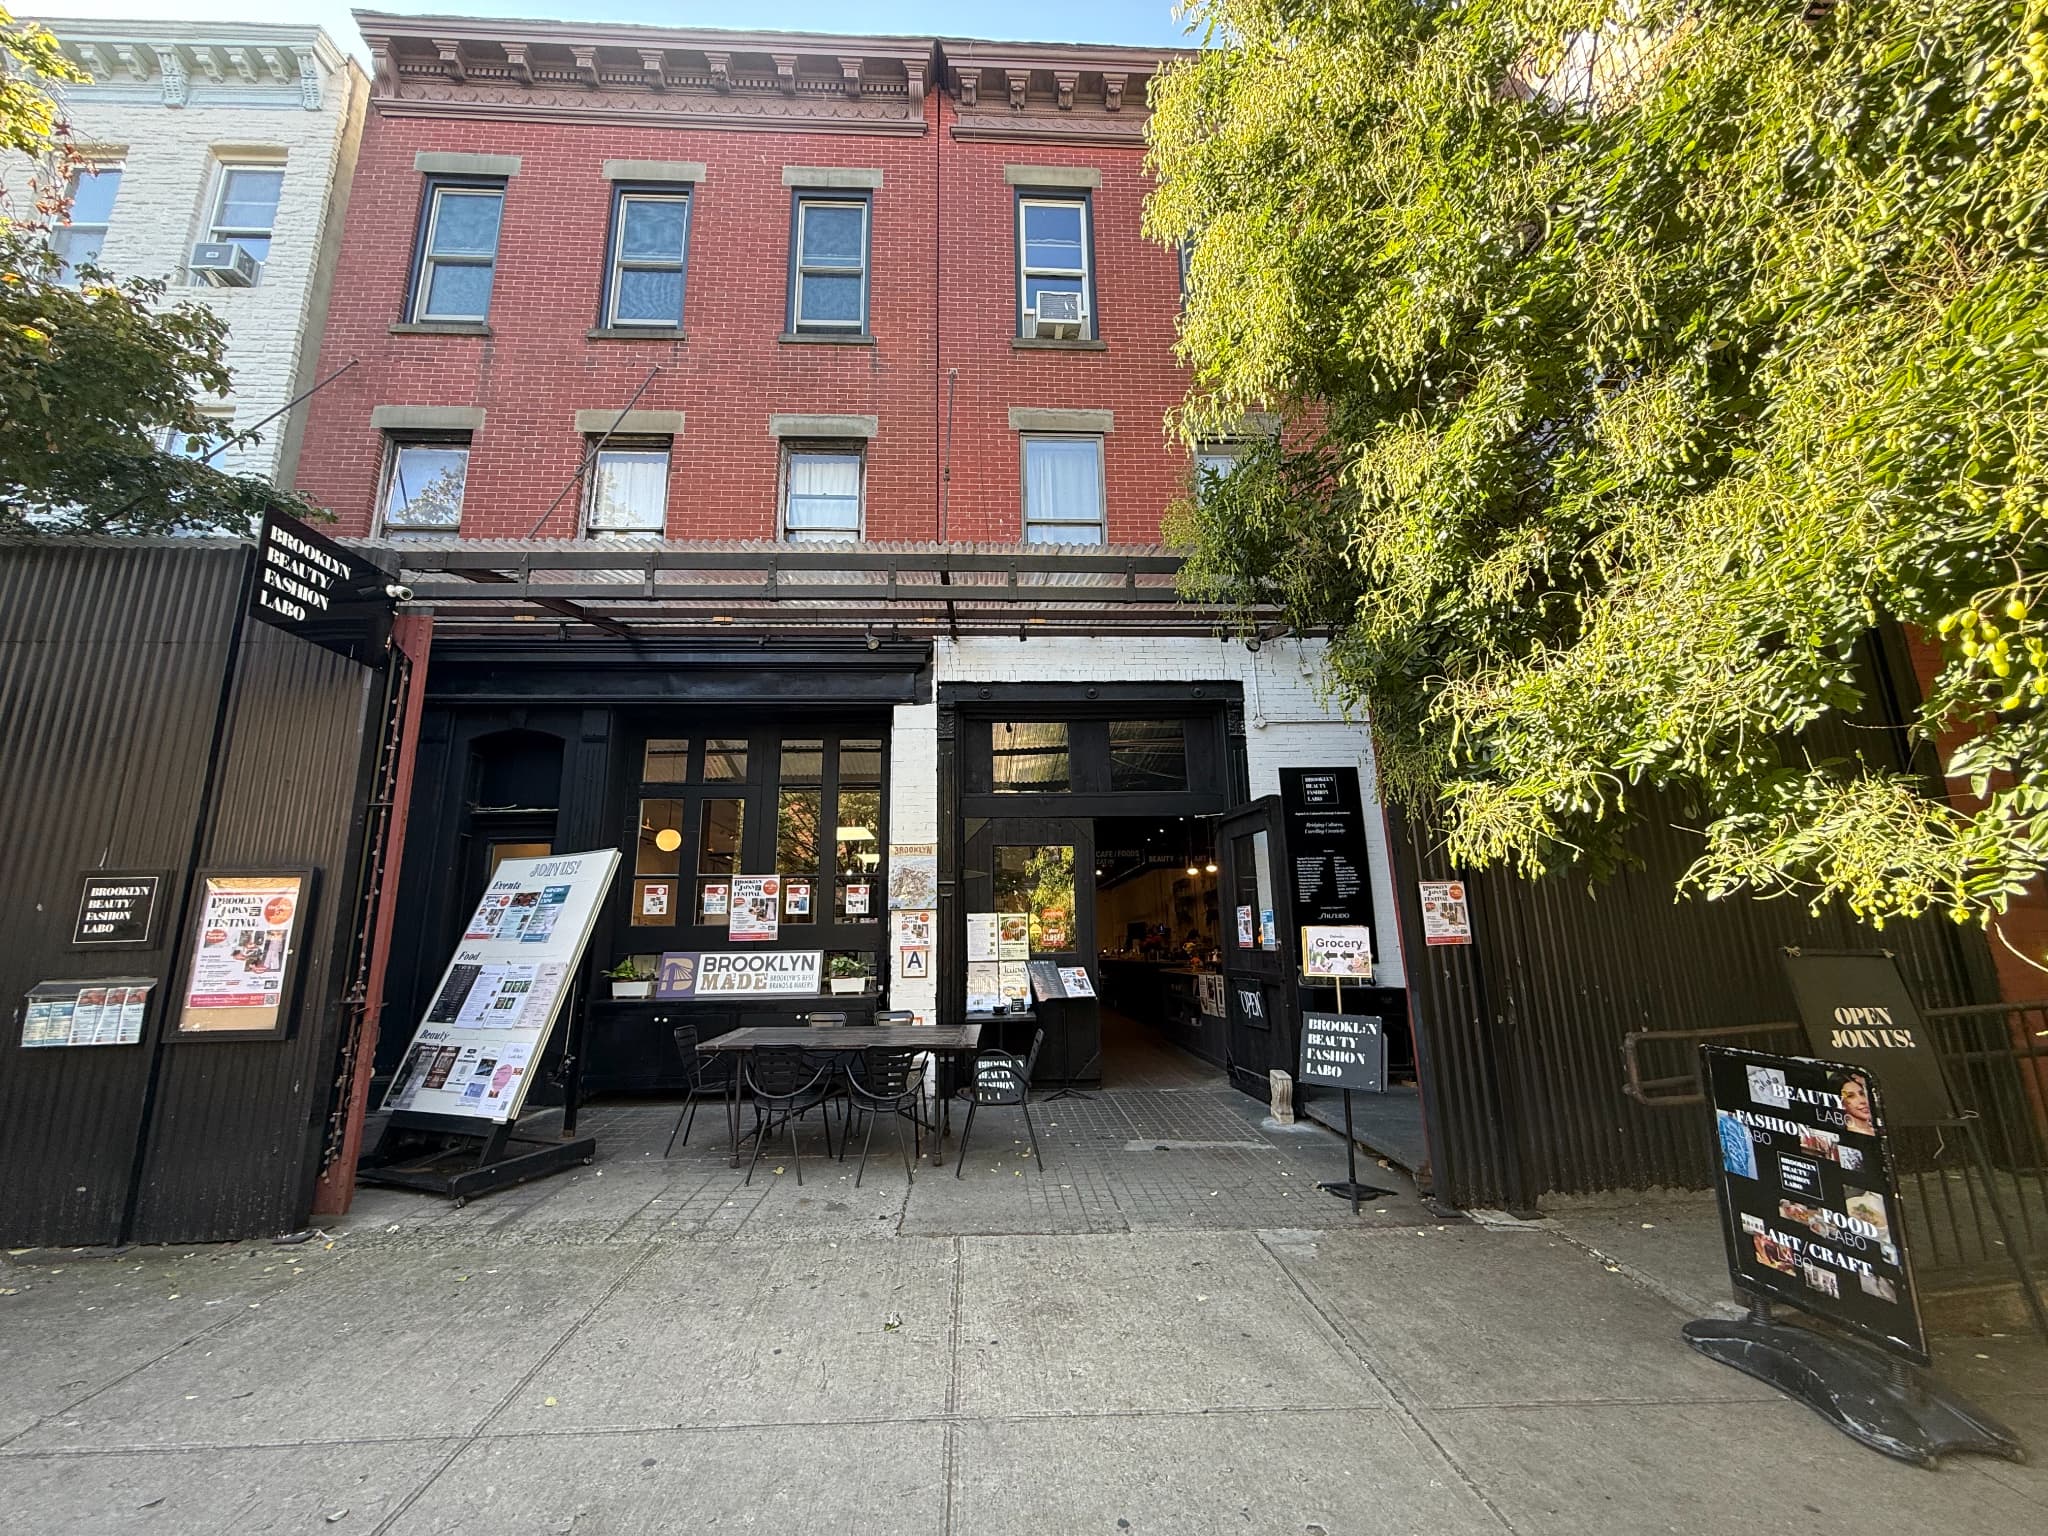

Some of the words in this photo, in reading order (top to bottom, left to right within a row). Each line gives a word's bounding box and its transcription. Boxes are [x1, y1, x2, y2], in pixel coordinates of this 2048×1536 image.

[270, 525, 351, 580] BROOKLYN
[264, 568, 329, 611] FASHION
[260, 590, 306, 621] LABO
[530, 862, 560, 877] JOIN
[560, 860, 582, 875] US!
[91, 886, 150, 896] BROOKLYN
[492, 880, 521, 890] Events
[211, 897, 263, 908] BROOKLYN
[86, 911, 132, 920] FASHION
[207, 919, 258, 928] FESTIVAL
[83, 924, 114, 934] LABO
[1316, 938, 1362, 950] Grocery
[458, 951, 482, 960] Food
[703, 955, 815, 972] BROOKLYN
[907, 951, 922, 968] A
[700, 972, 768, 991] MADE
[1238, 990, 1264, 1019] OPEN
[1834, 1008, 1893, 1025] OPEN
[1308, 1018, 1378, 1035] BROOKLYN
[419, 1029, 450, 1042] Beauty
[1308, 1033, 1358, 1048] BEAUTY
[1831, 1030, 1880, 1048] JOIN
[1880, 1030, 1916, 1048] US!
[978, 1060, 1024, 1068] BROOKLN
[1307, 1048, 1366, 1064] FASHION
[1306, 1062, 1342, 1078] LABO
[1772, 1083, 1846, 1110] BEAUTY
[1736, 1109, 1811, 1138] FASHION
[1816, 1108, 1856, 1128] LABO
[1780, 1157, 1816, 1172] BROOKLYN
[1783, 1172, 1810, 1185] FASHION
[1784, 1180, 1804, 1190] LABO
[1820, 1208, 1878, 1238] FOOD
[1827, 1230, 1867, 1250] LABO
[1777, 1248, 1814, 1270] LABO
